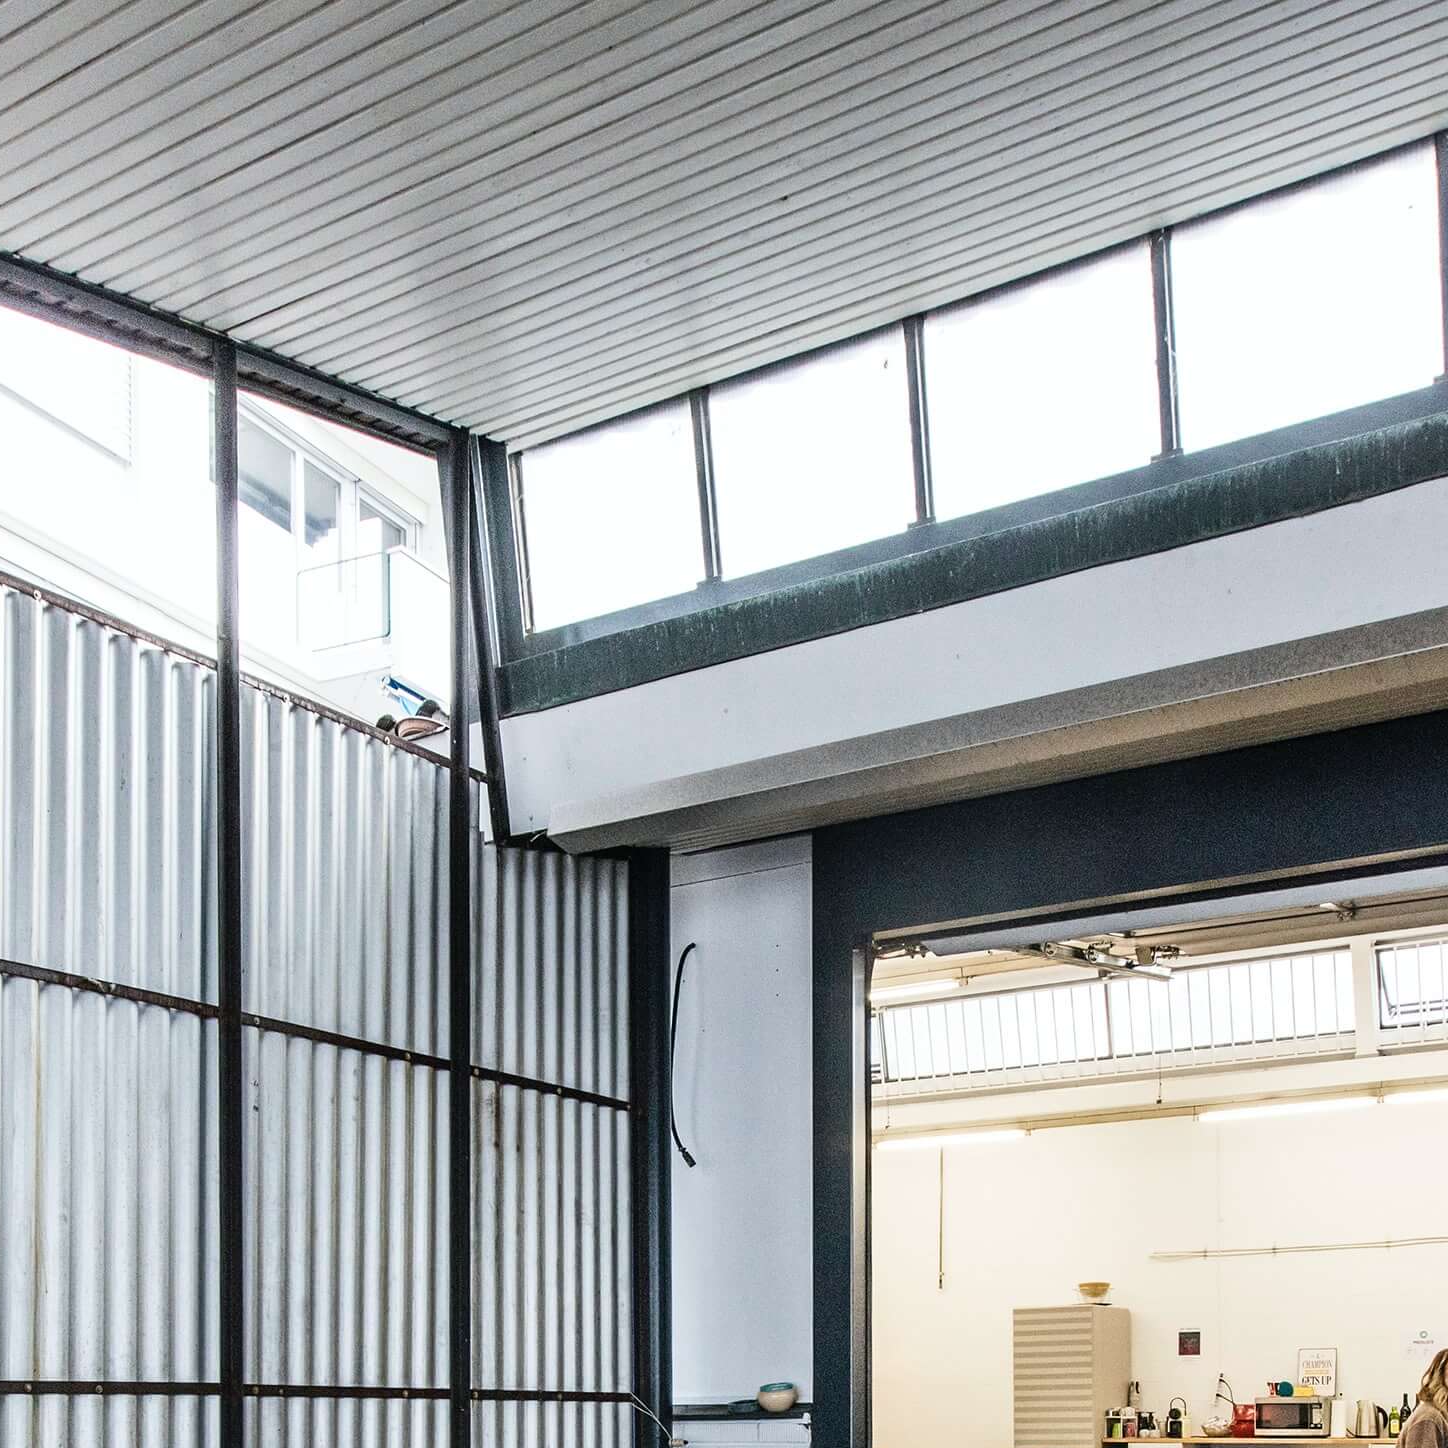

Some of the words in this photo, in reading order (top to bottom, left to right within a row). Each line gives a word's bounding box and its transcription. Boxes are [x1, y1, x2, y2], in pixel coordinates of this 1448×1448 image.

[1302, 1359, 1333, 1369] CHAMPION
[1301, 1376, 1320, 1385] GETS
[1321, 1376, 1332, 1385] UP
